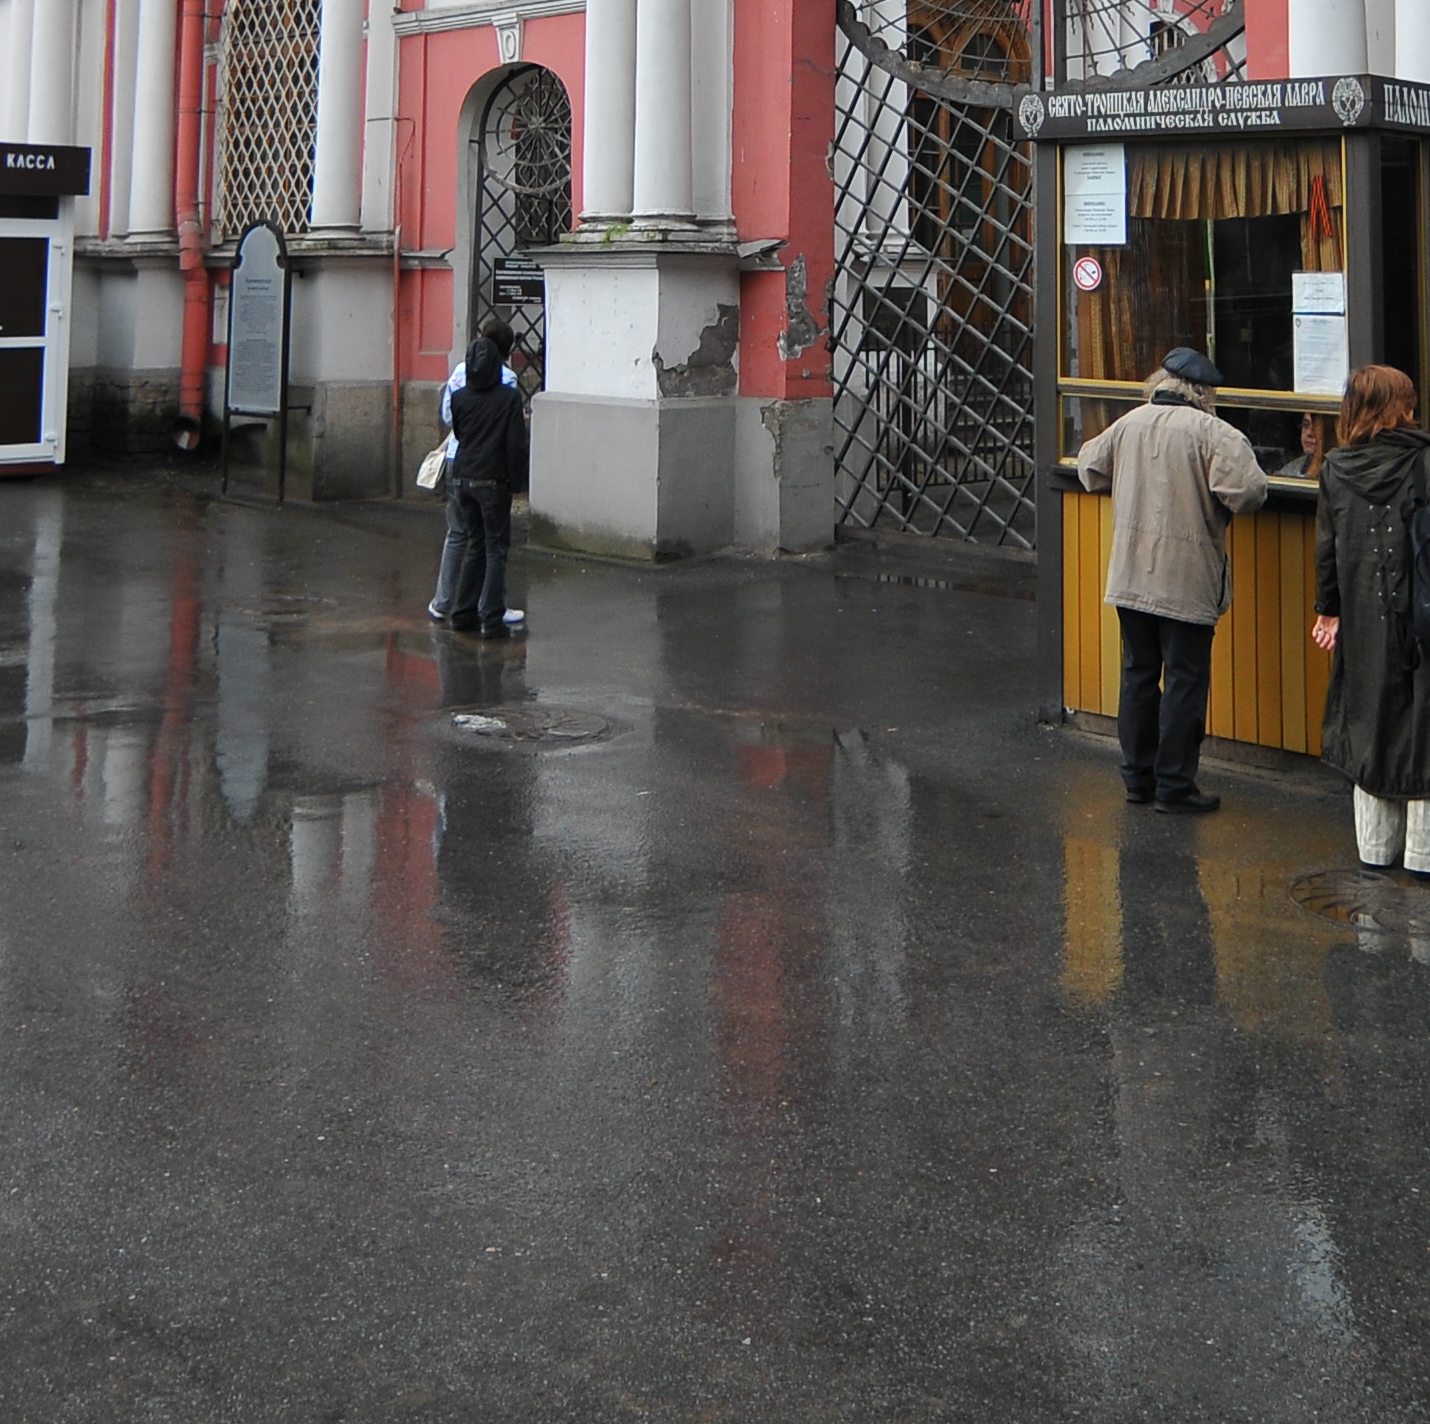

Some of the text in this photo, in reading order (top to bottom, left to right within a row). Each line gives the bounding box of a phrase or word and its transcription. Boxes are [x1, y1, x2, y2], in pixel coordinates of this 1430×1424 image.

[1285, 81, 1326, 106] ЛАВРА
[1087, 110, 1281, 131] ПАЛОМНИЧЕСКАЯ СЛУЖБА
[6, 153, 56, 170] КАССА
